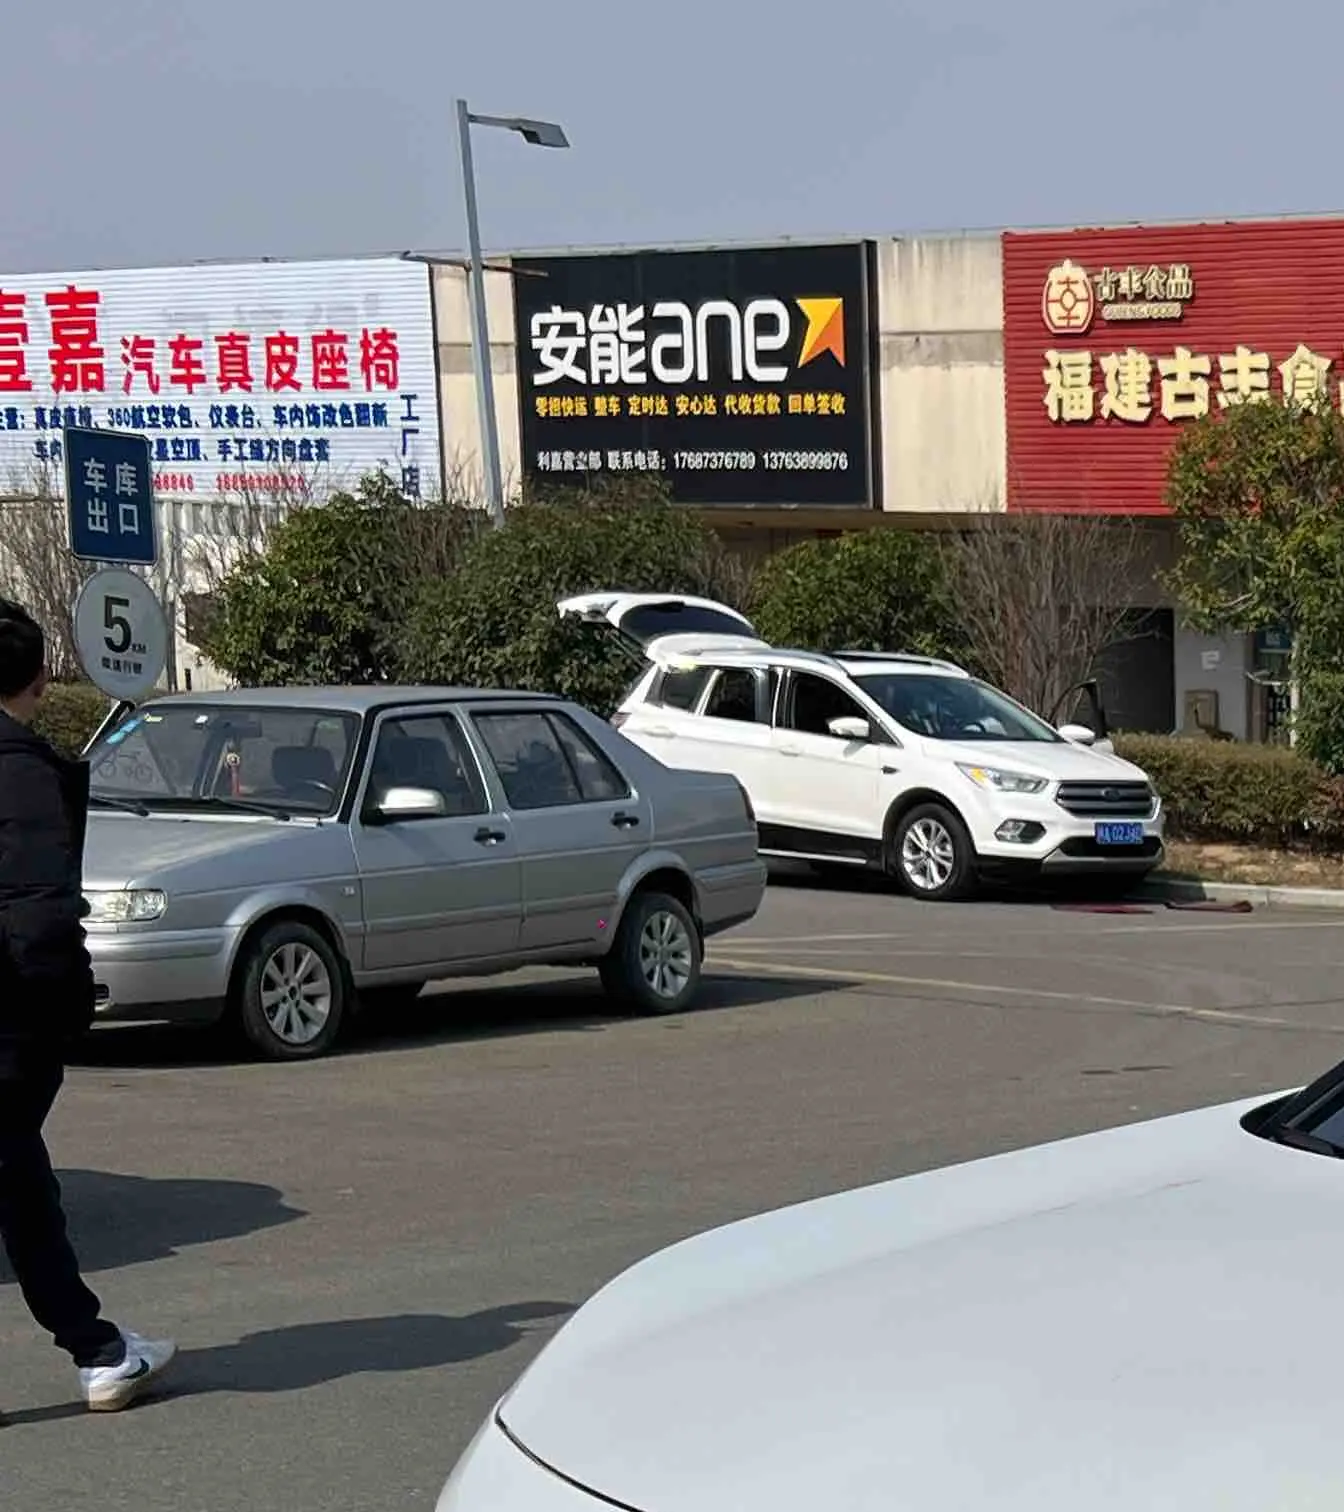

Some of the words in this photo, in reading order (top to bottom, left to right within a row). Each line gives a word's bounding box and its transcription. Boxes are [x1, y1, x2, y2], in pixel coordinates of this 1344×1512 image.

[119, 327, 402, 396] 汽车真皮座椅
[530, 303, 647, 386] 安能
[650, 298, 790, 383] ane
[627, 394, 669, 416] 定时达
[83, 457, 139, 497] 车库
[87, 498, 140, 536] 出口
[103, 594, 132, 654] 5
